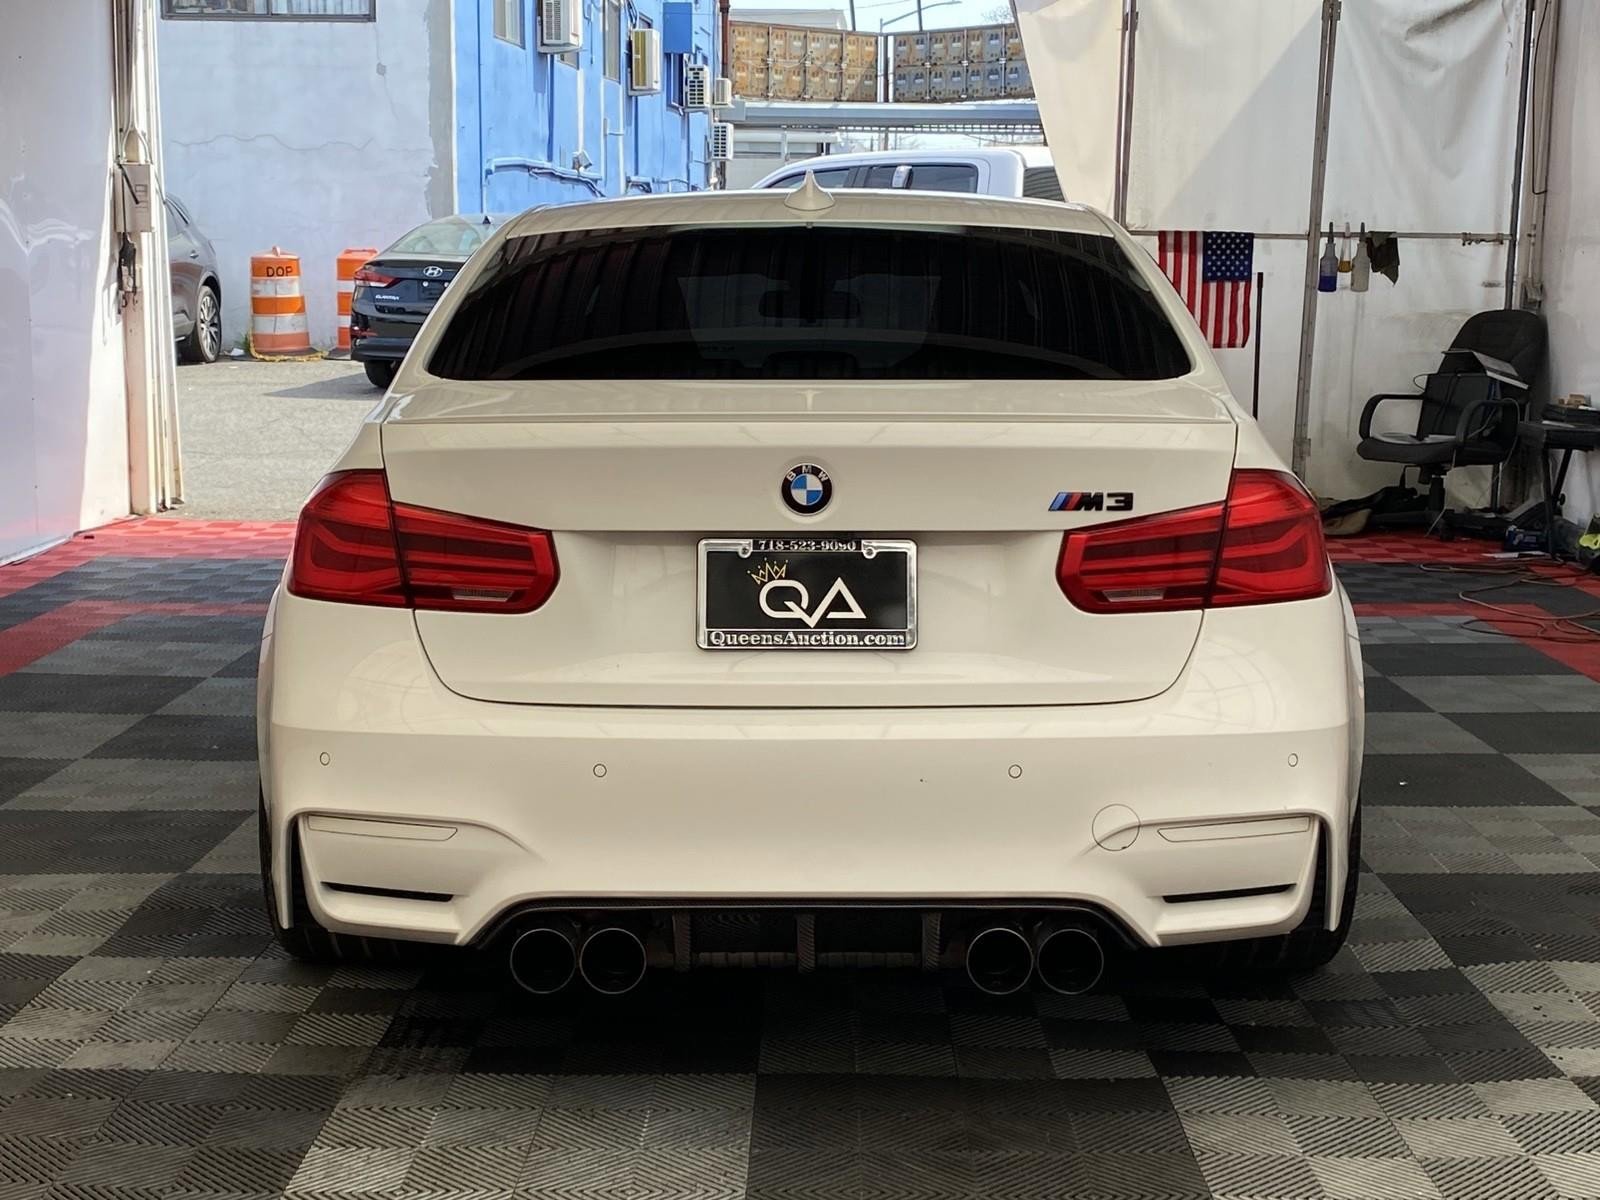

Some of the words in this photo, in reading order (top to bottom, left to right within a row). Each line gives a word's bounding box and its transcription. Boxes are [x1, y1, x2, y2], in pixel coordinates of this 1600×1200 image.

[266, 266, 293, 277] DOP
[786, 465, 829, 481] BMW
[1048, 492, 1133, 511] M3
[759, 577, 867, 628] QA
[710, 631, 905, 646] QueensAuction.com
